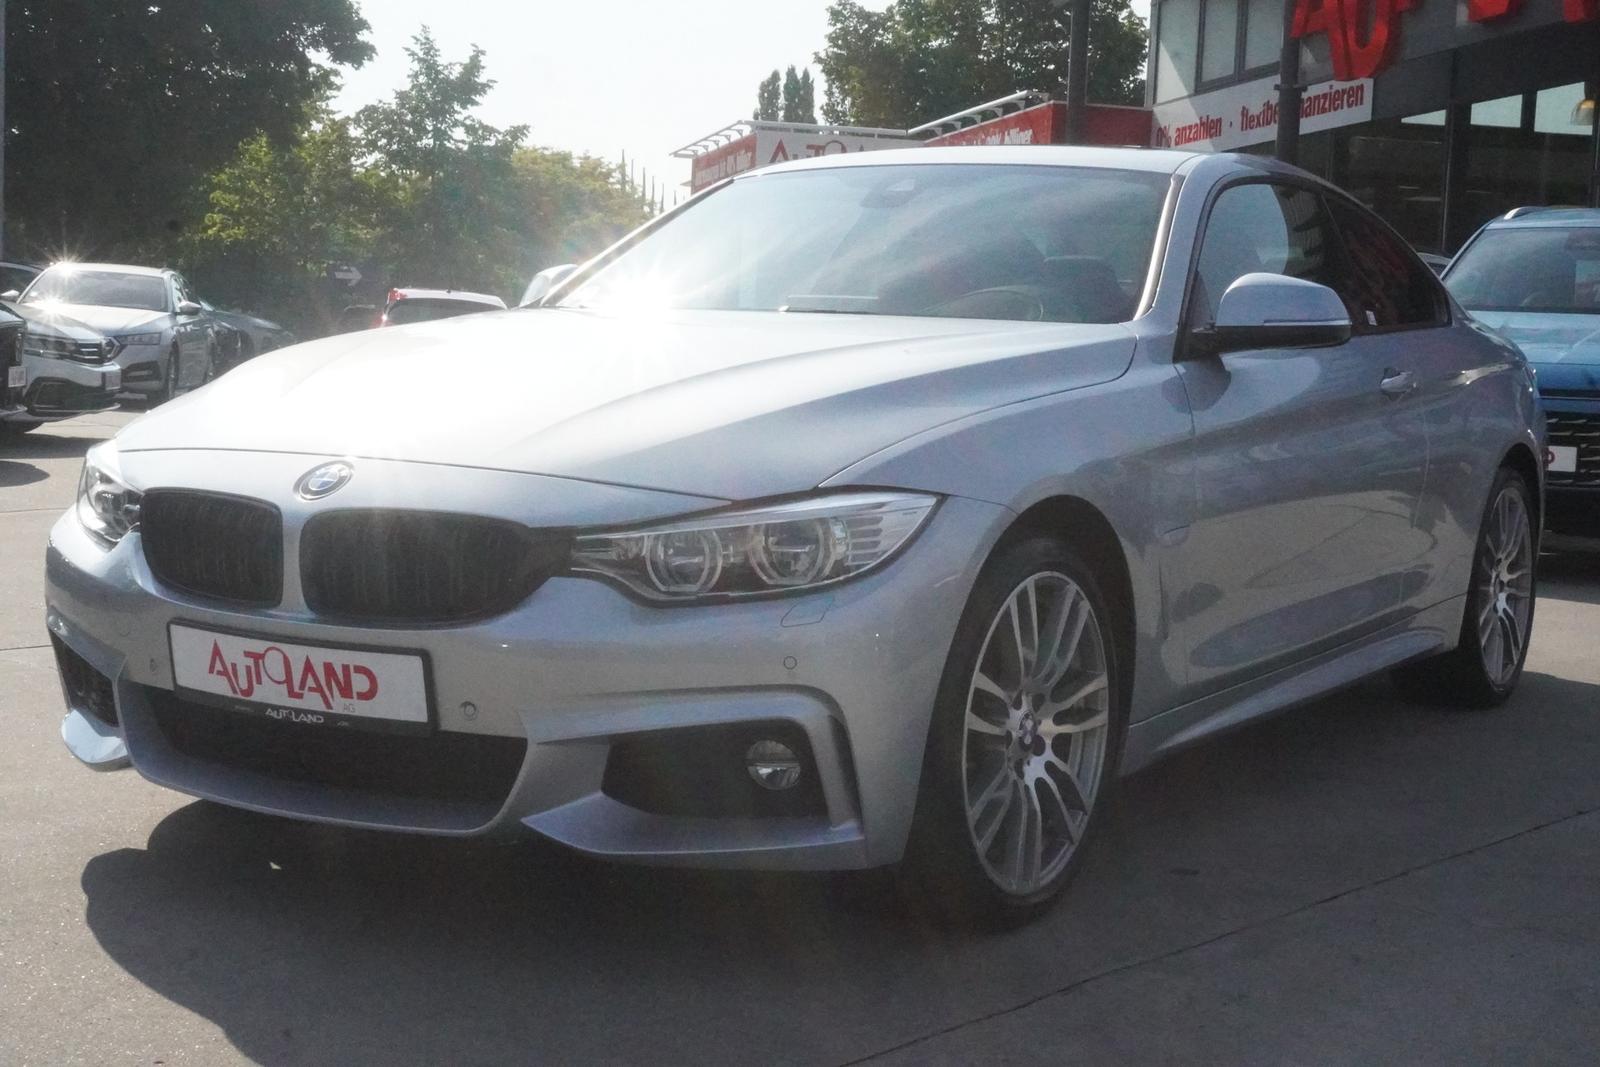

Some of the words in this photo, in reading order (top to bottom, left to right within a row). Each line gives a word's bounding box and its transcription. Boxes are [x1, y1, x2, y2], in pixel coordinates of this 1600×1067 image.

[1174, 114, 1223, 147] anzahlen
[1241, 100, 1281, 132] flexibe
[1299, 83, 1365, 119] anzieren
[208, 638, 379, 710] AUTOLAND
